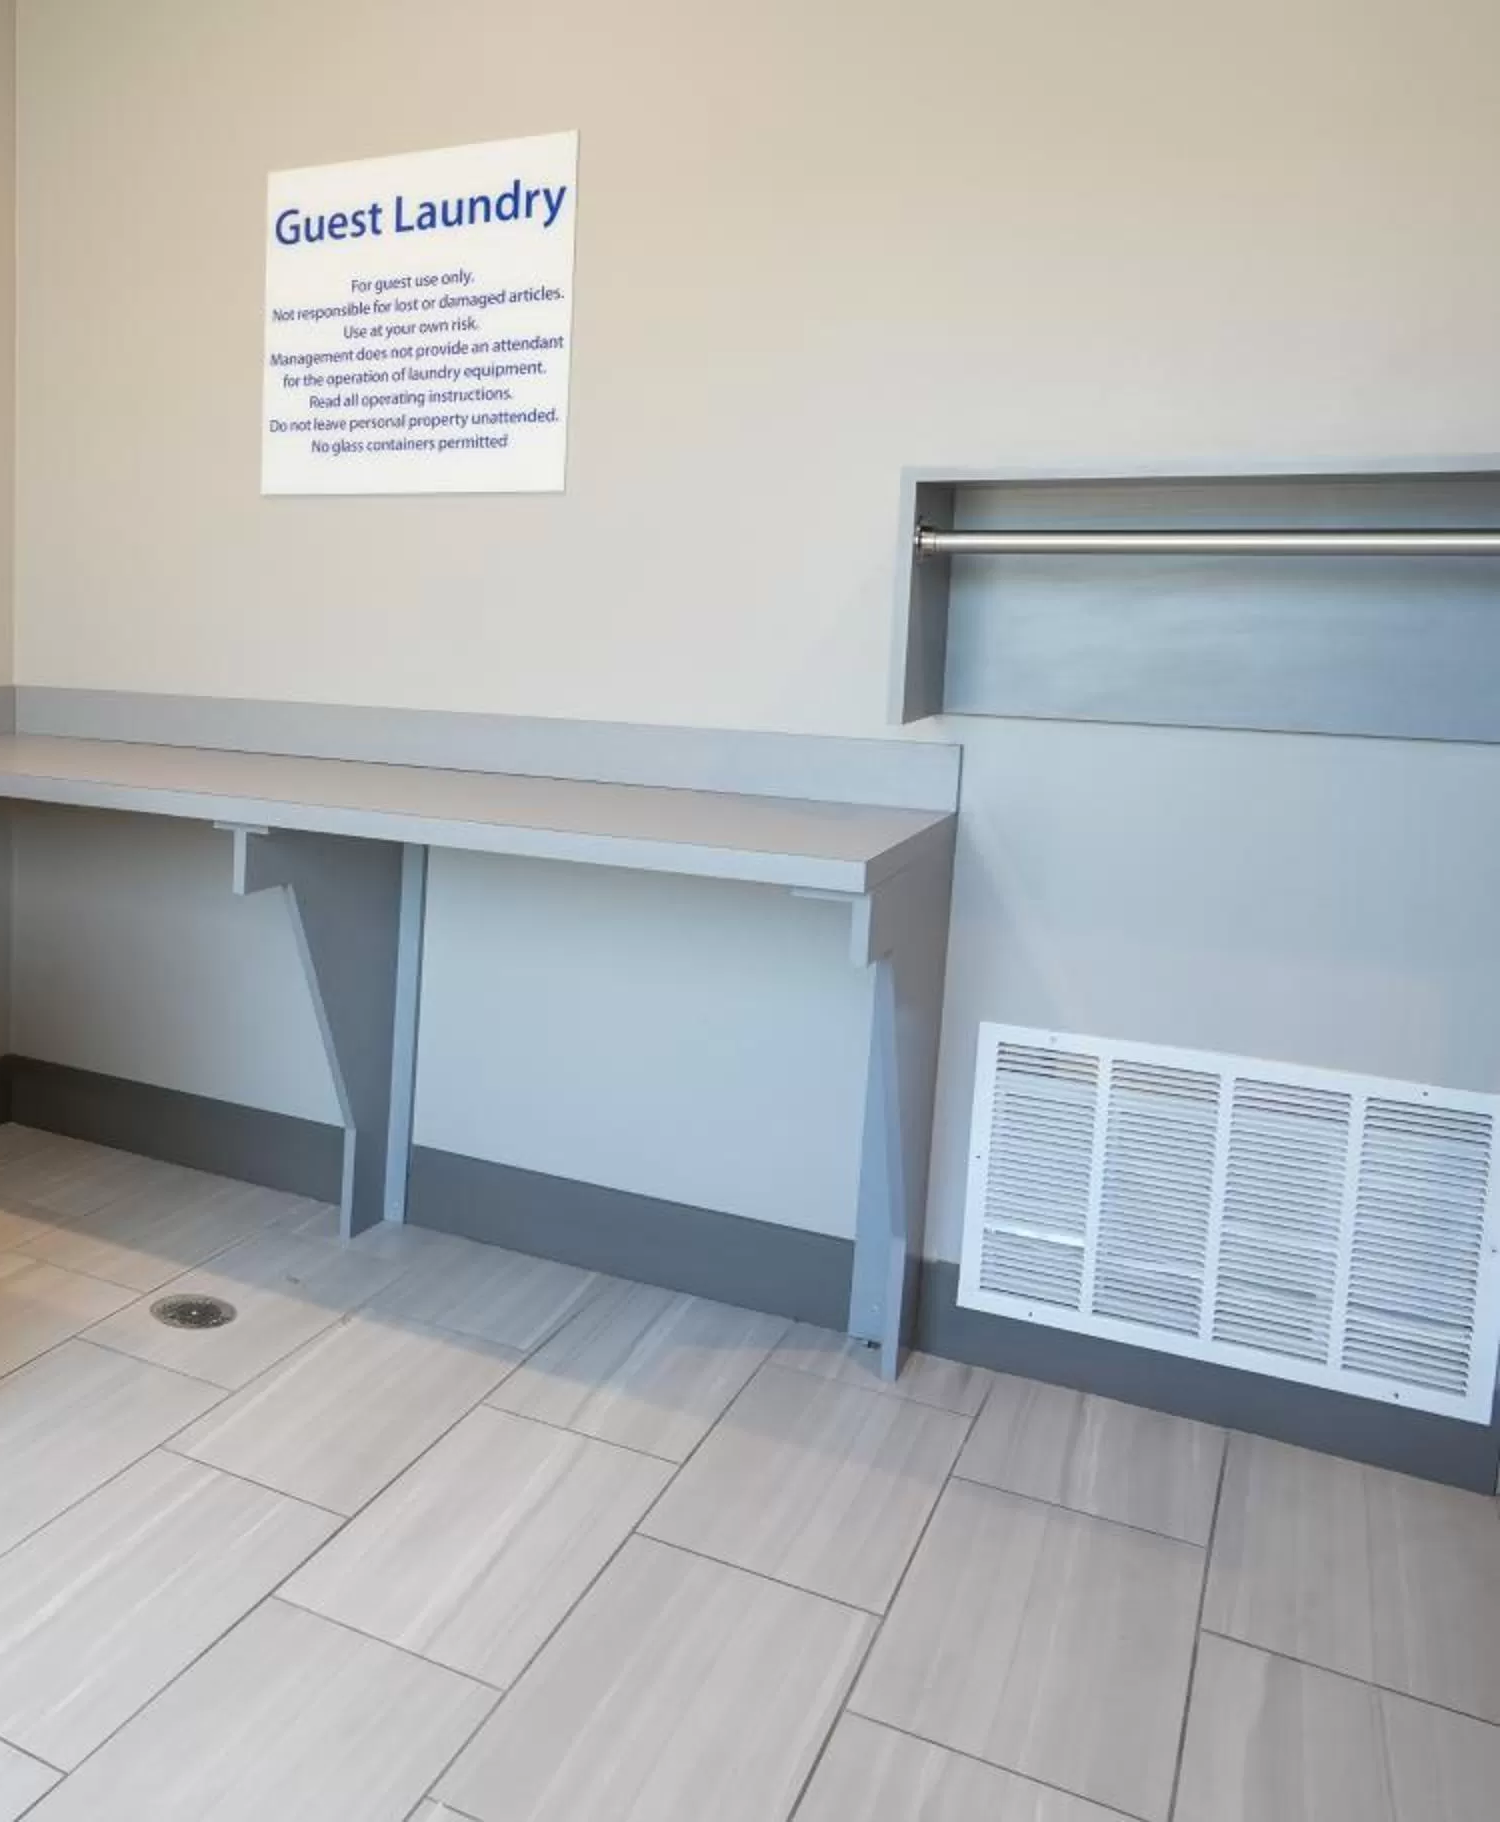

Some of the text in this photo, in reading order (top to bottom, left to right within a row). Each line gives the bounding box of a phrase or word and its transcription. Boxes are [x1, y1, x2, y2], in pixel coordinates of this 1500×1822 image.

[276, 179, 566, 245] Guest Laundry
[351, 268, 475, 295] For guest use only.
[272, 284, 565, 323] Not responsible for lost or damaged articles.
[343, 315, 480, 339] Use at your own risk.
[270, 335, 565, 368] Management does not provide an attendant
[283, 361, 547, 388] for the operation of laundry equipment.
[309, 386, 513, 409] Read all operating instructions.
[269, 407, 559, 433] Do not leave personal property unattended.
[311, 433, 510, 456] No glass containers permitted
